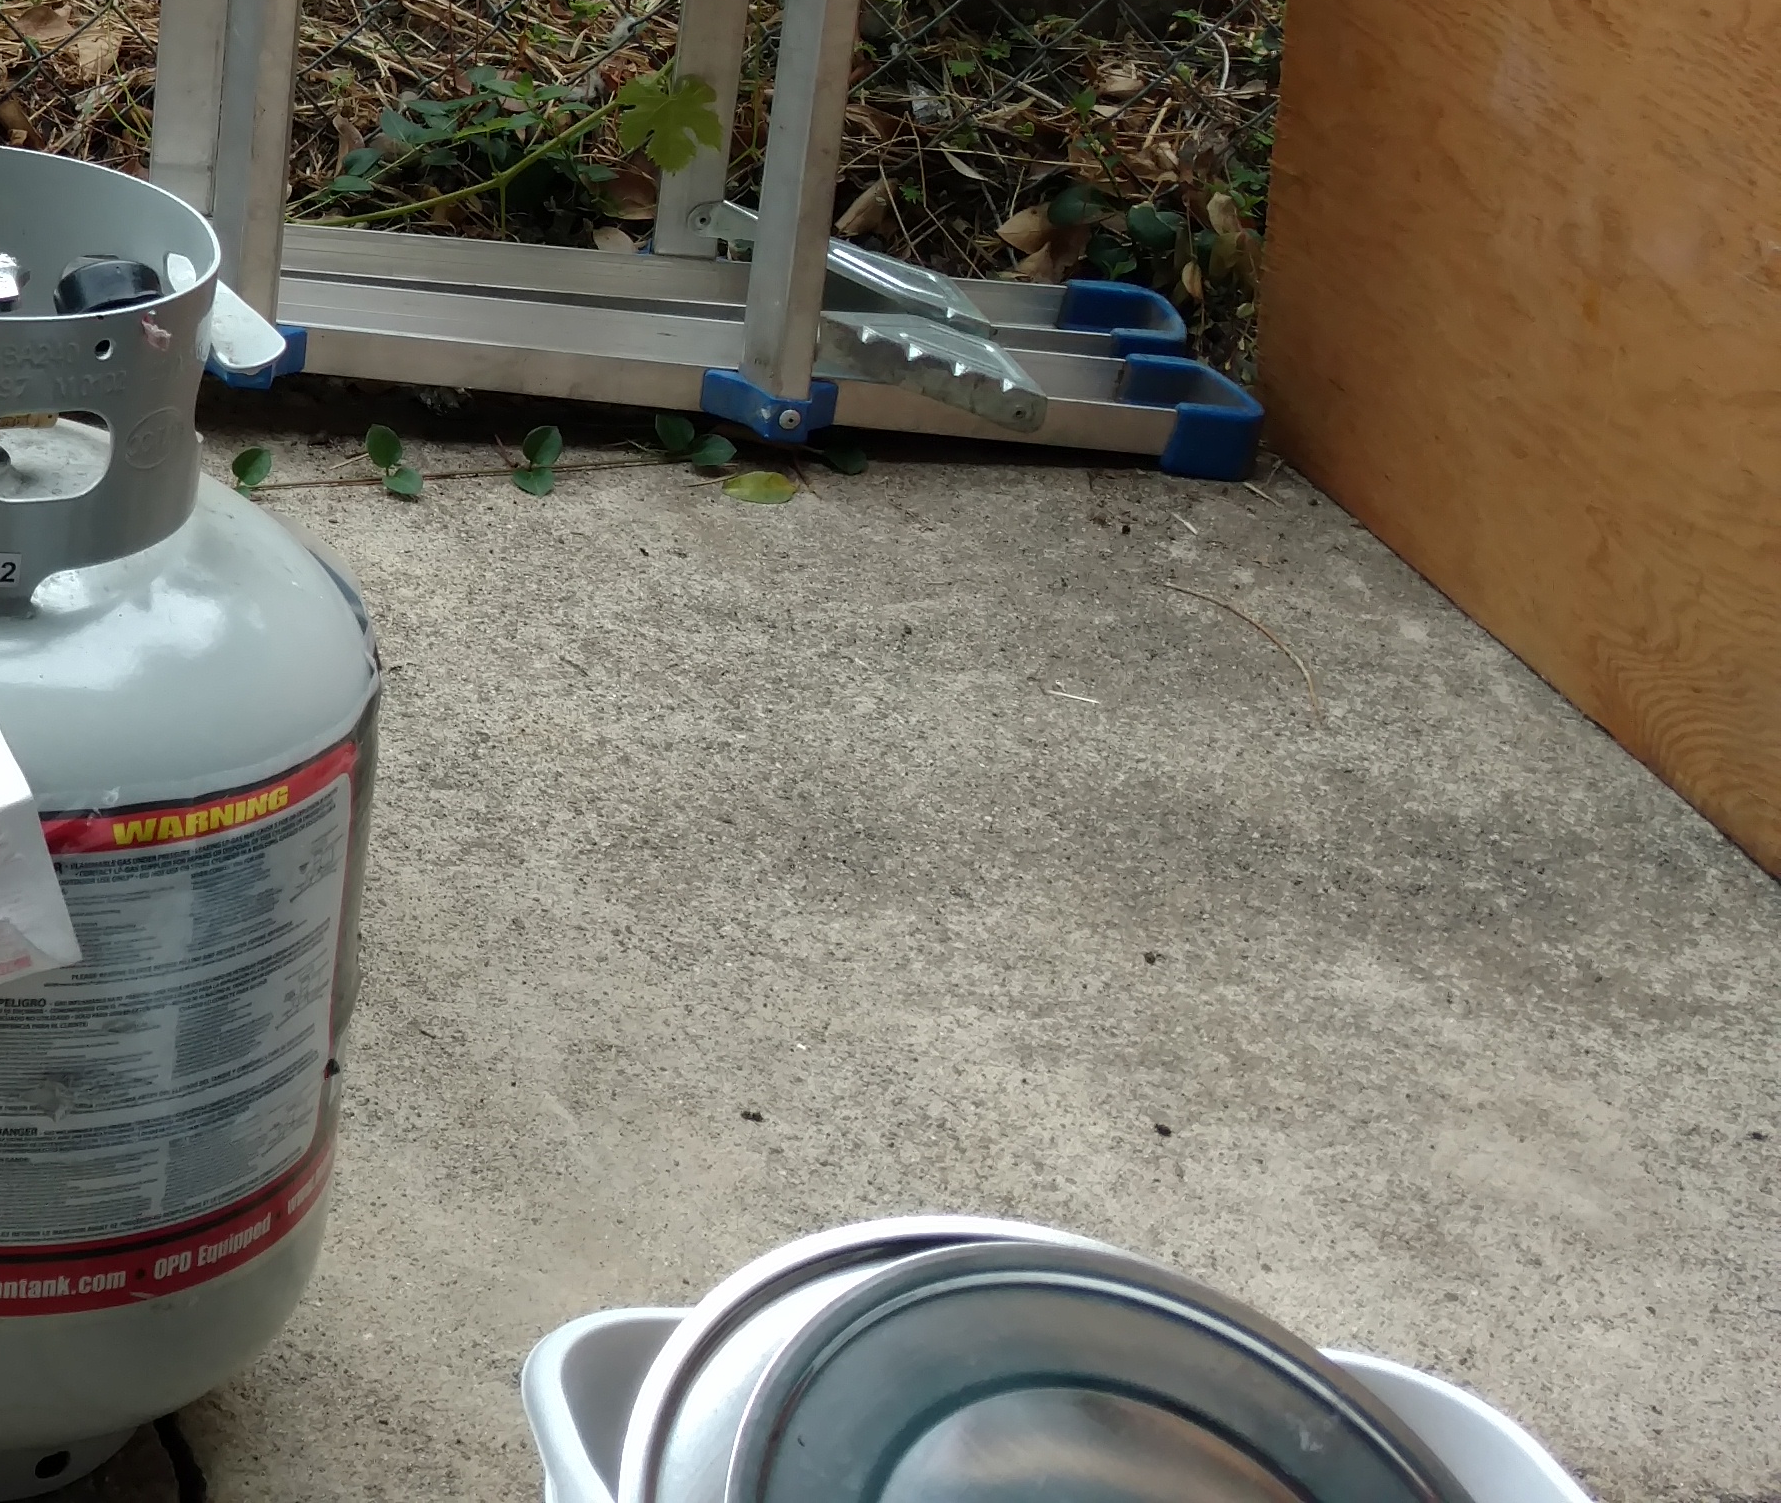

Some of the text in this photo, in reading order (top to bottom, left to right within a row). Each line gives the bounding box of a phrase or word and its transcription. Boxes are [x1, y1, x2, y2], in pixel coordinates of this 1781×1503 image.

[111, 785, 289, 846] WARNING
[153, 1214, 272, 1281] OPD Equipped
